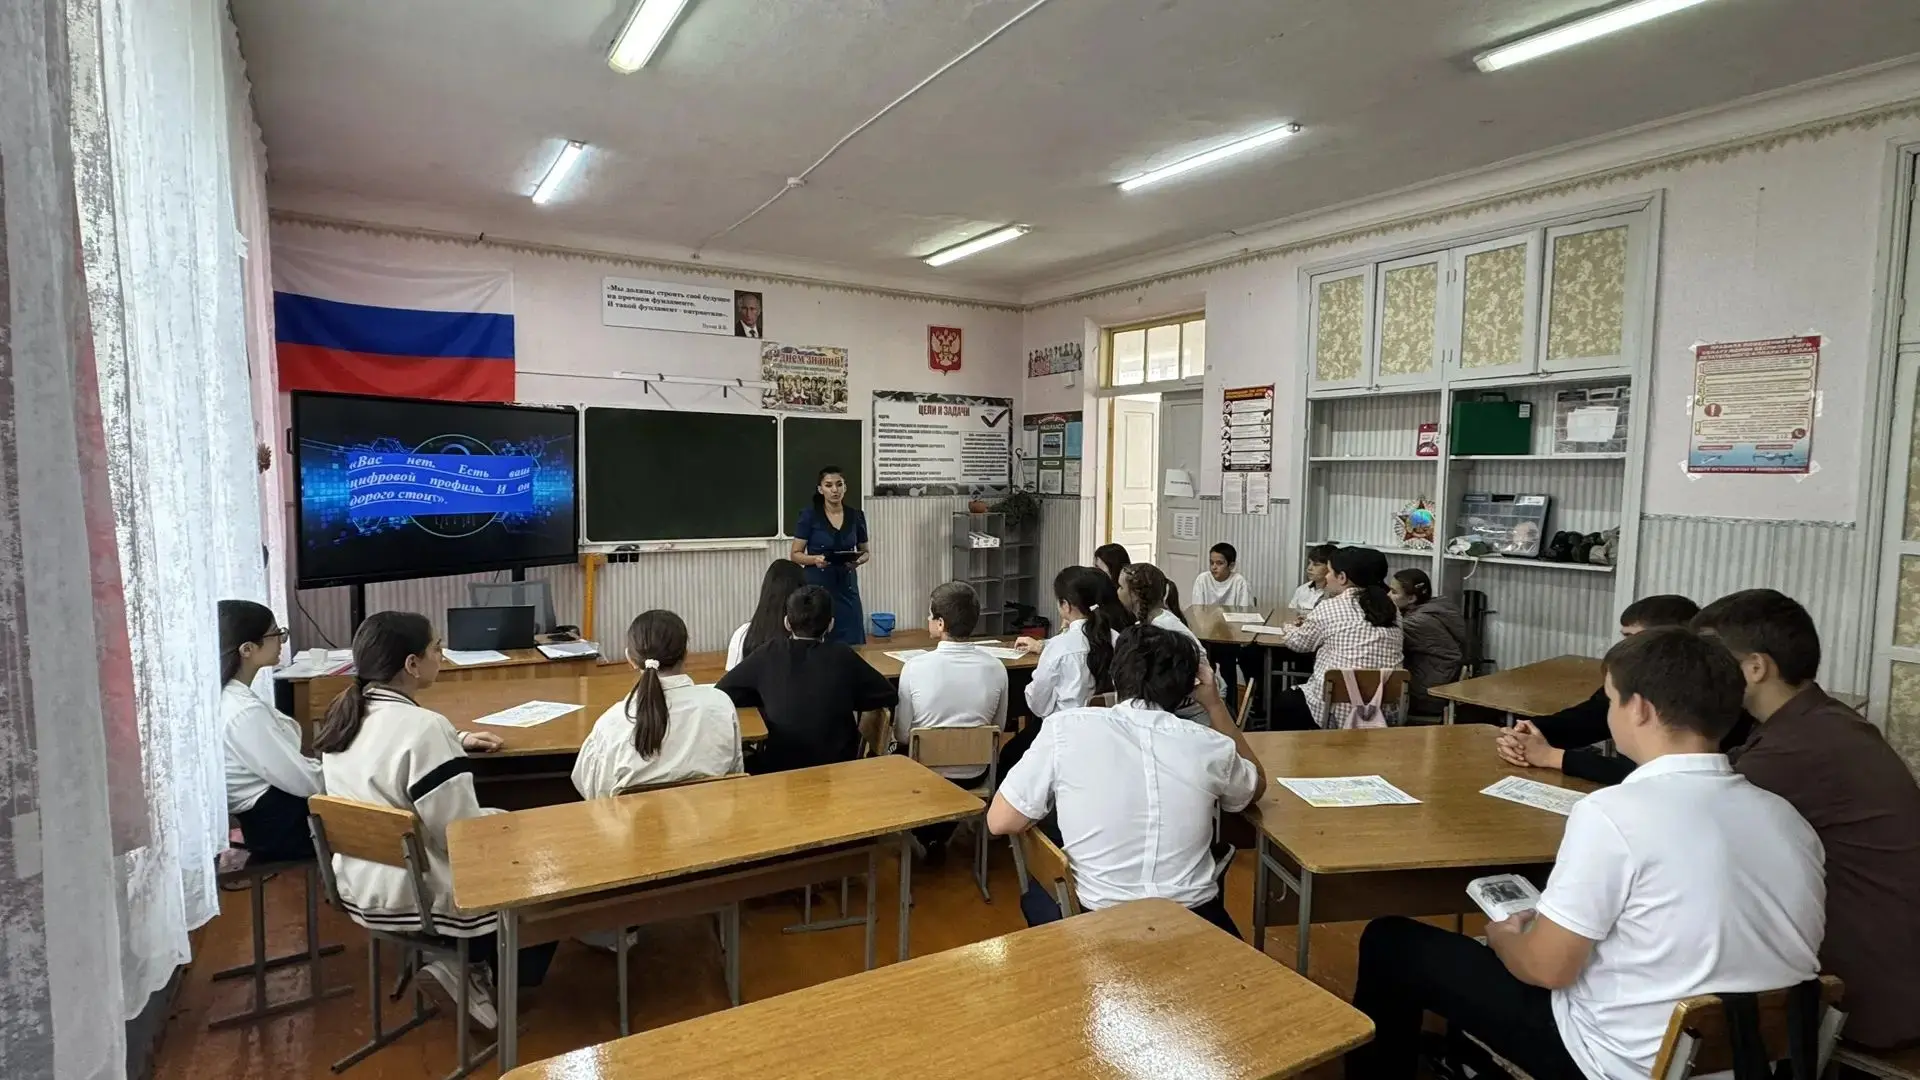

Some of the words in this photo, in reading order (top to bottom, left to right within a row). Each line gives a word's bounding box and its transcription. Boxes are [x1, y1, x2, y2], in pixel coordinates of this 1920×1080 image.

[918, 404, 937, 416] ЦЕЛИ
[938, 405, 943, 415] И
[944, 405, 970, 417] ЗАДАЧИ
[349, 455, 383, 470] «Вас
[406, 457, 436, 468] нет.
[458, 464, 490, 478] Есть
[508, 467, 531, 478] ваш
[350, 472, 416, 489] цифровой
[429, 477, 484, 494] профиль.
[496, 484, 508, 495] И
[517, 482, 531, 492] он
[349, 491, 395, 507] дорого
[397, 491, 448, 505] стоит».
